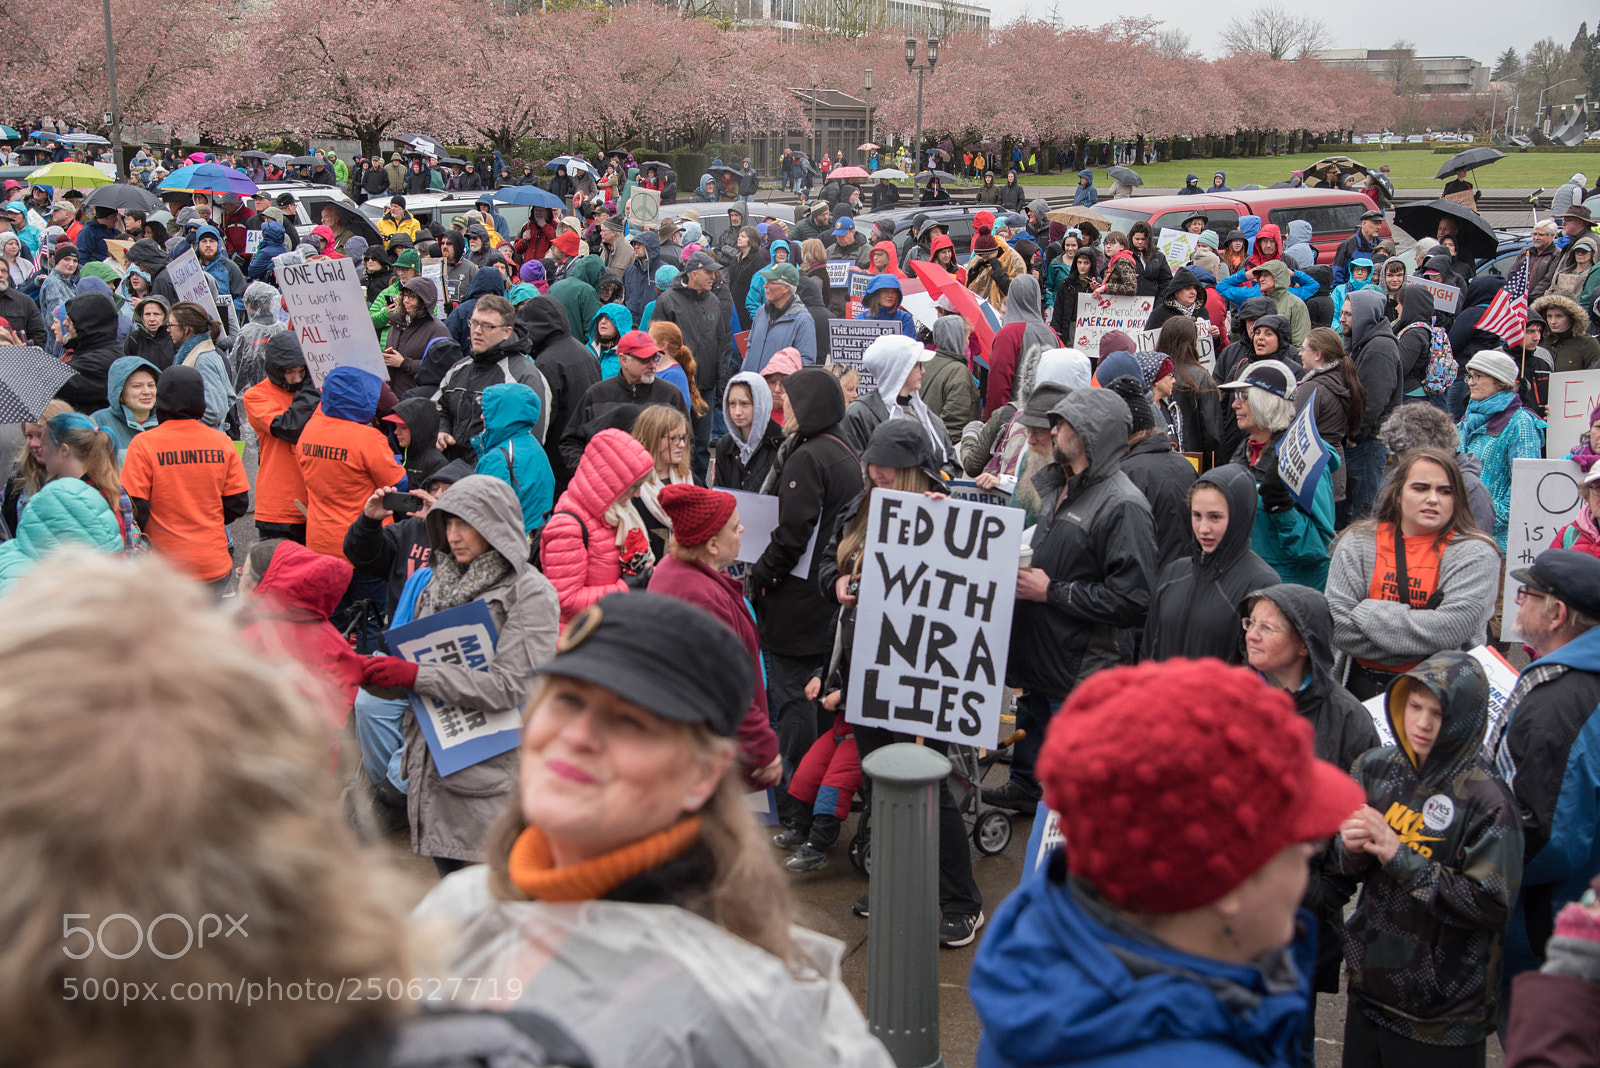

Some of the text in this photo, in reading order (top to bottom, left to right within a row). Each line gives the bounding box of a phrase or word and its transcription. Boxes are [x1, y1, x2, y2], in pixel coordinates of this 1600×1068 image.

[283, 264, 315, 286] ONE
[309, 290, 342, 305] worth
[293, 308, 350, 326] more than
[1076, 316, 1124, 328] AMERICAN
[301, 324, 352, 345] ALL the
[832, 327, 894, 336] THE NUMBER OF
[833, 338, 861, 348] BULLET
[307, 350, 335, 372] guns
[833, 350, 862, 360] IN THIS
[157, 449, 225, 466] VOLUNTEER
[302, 443, 348, 462] VOLUNTEER
[944, 506, 1006, 561] UP
[875, 612, 996, 687] NRA
[862, 669, 985, 737] LIES
